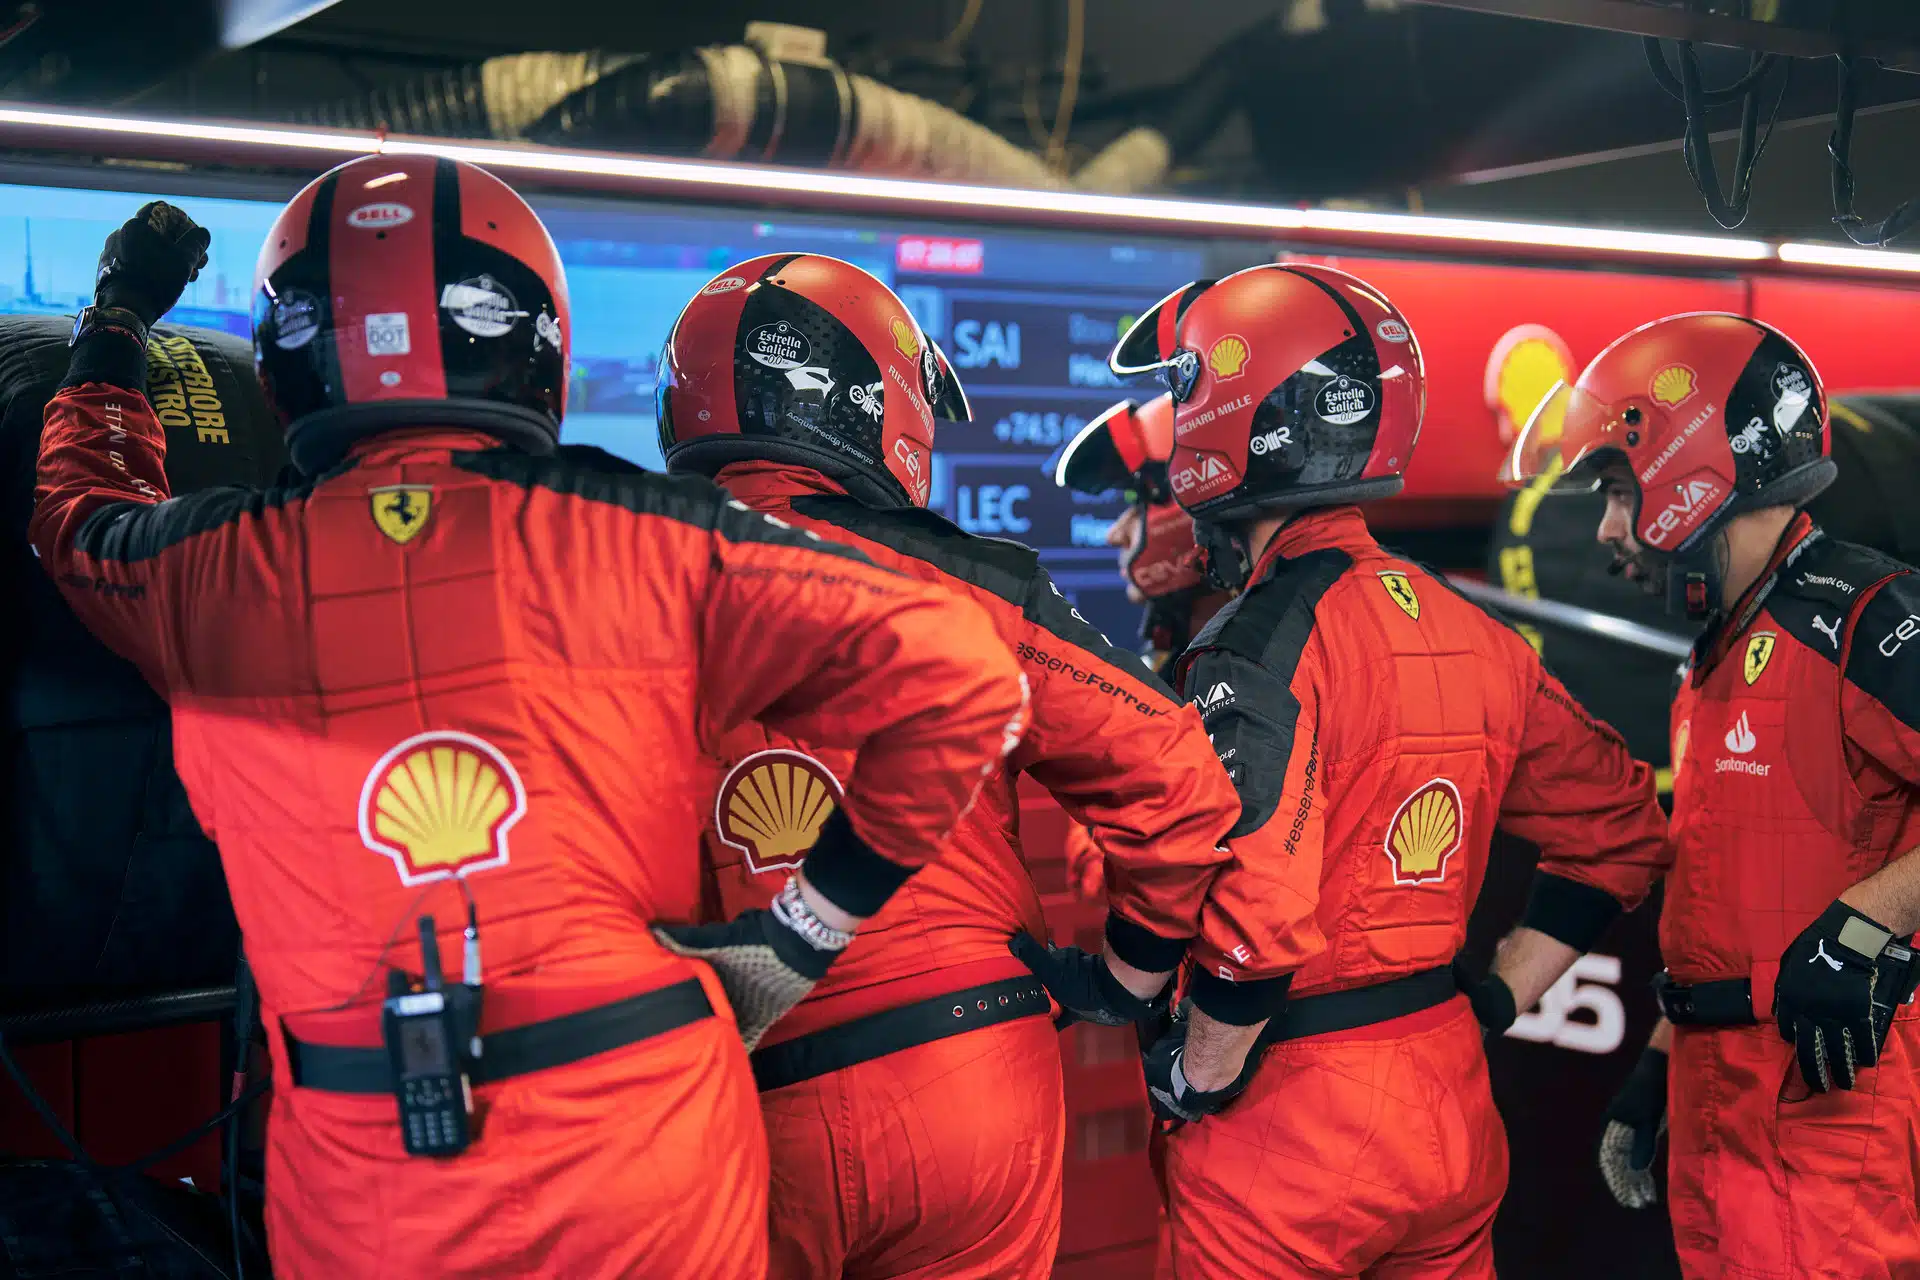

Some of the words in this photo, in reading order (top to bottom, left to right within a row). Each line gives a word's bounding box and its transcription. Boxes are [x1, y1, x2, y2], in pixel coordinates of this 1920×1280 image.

[356, 208, 402, 222] BELL
[708, 280, 738, 292] BELL
[757, 330, 802, 349] Estrella
[1381, 326, 1405, 336] BELL
[757, 340, 797, 359] Galicia
[953, 320, 1021, 369] SAI
[888, 364, 921, 412] RICHARD
[1325, 388, 1365, 403] Estrella
[1176, 410, 1216, 437] RICHARD
[1217, 394, 1253, 417] MILLE
[786, 411, 841, 447] Acquafredda
[841, 441, 874, 465] Vincenzo
[1640, 435, 1686, 484] RICHARD
[1683, 402, 1717, 437] MILLE
[1196, 473, 1233, 493] LOGISTICS
[957, 485, 1032, 534] LEC
[1683, 487, 1721, 528] LOGISTICS
[1714, 757, 1771, 776] Santander
